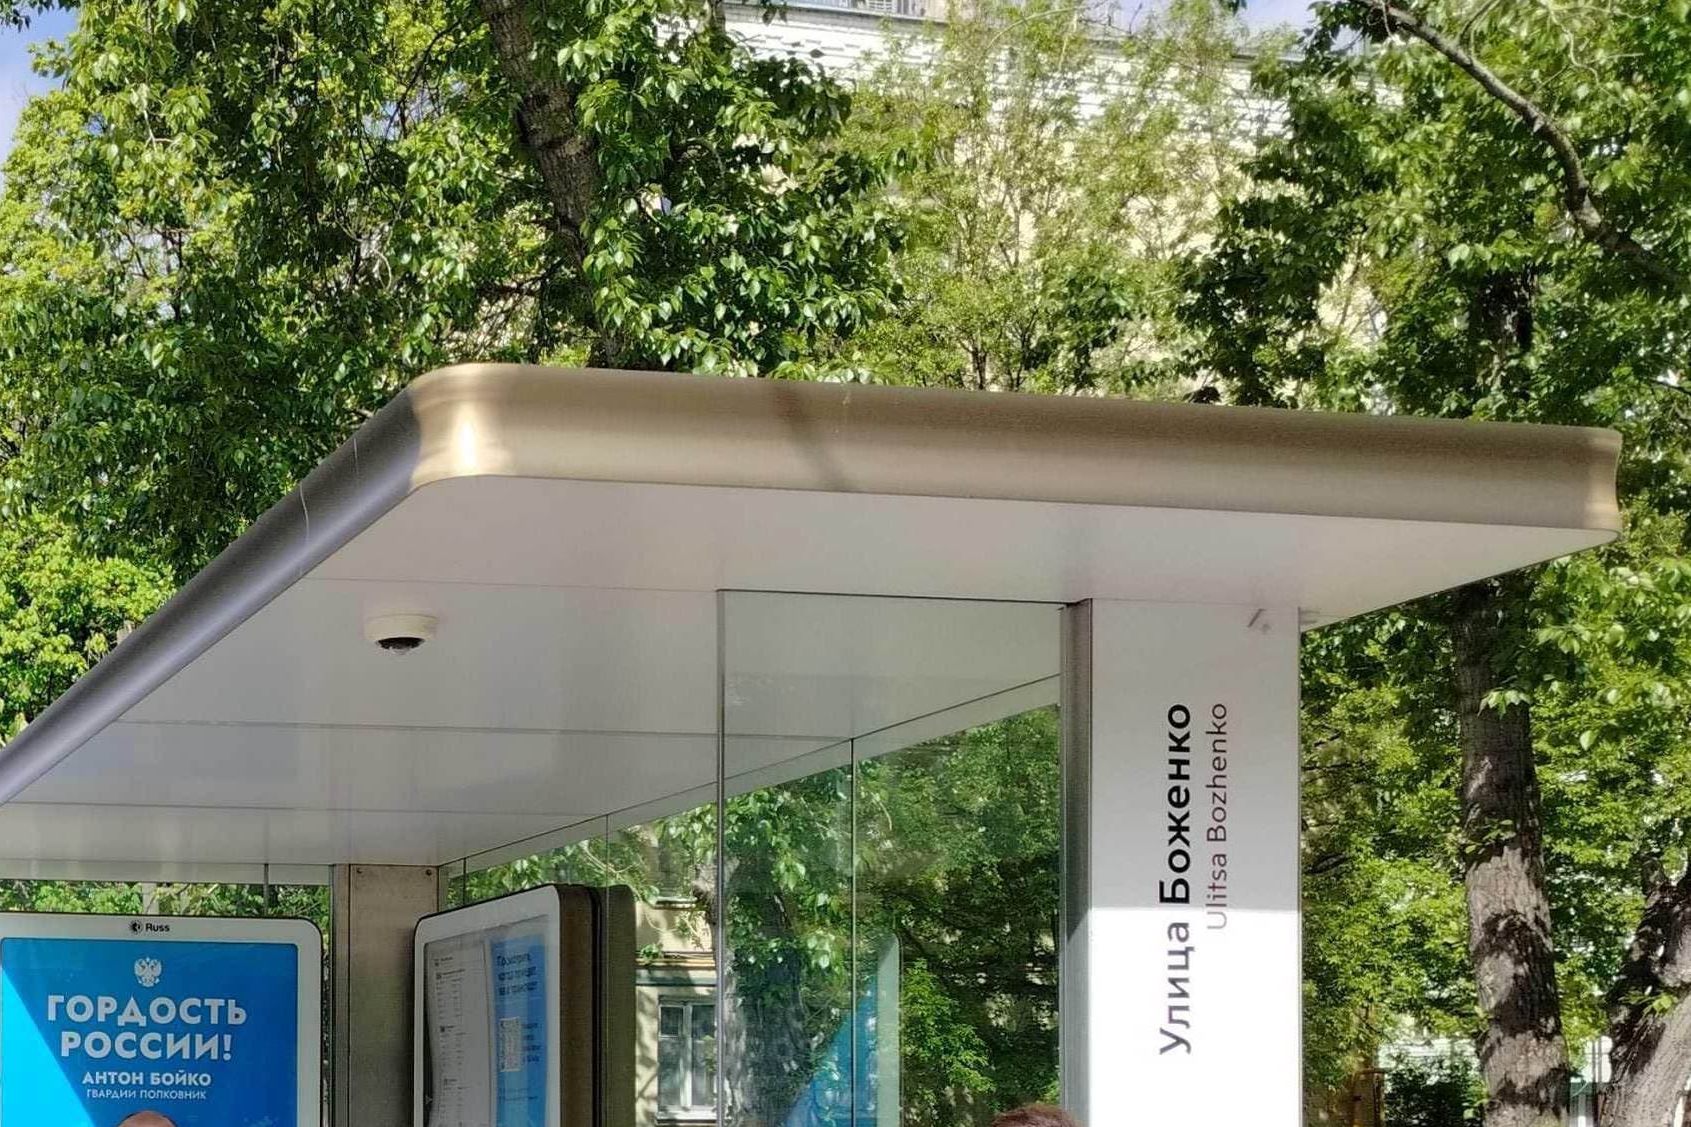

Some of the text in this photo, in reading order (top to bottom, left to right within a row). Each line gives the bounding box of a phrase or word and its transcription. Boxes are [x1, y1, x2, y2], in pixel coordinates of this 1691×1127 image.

[1206, 703, 1227, 930] Ulitsa Bozhenko
[1159, 703, 1195, 1055] Улица Боженко
[145, 923, 170, 932] Russ
[47, 995, 247, 1027] ГОРДОСТЬ
[61, 1031, 232, 1061] РОССИИ!
[82, 1070, 211, 1086] АНТОН БОЙКО
[87, 1089, 206, 1100] ГВАРДИИ ПОЛКОВНИК
